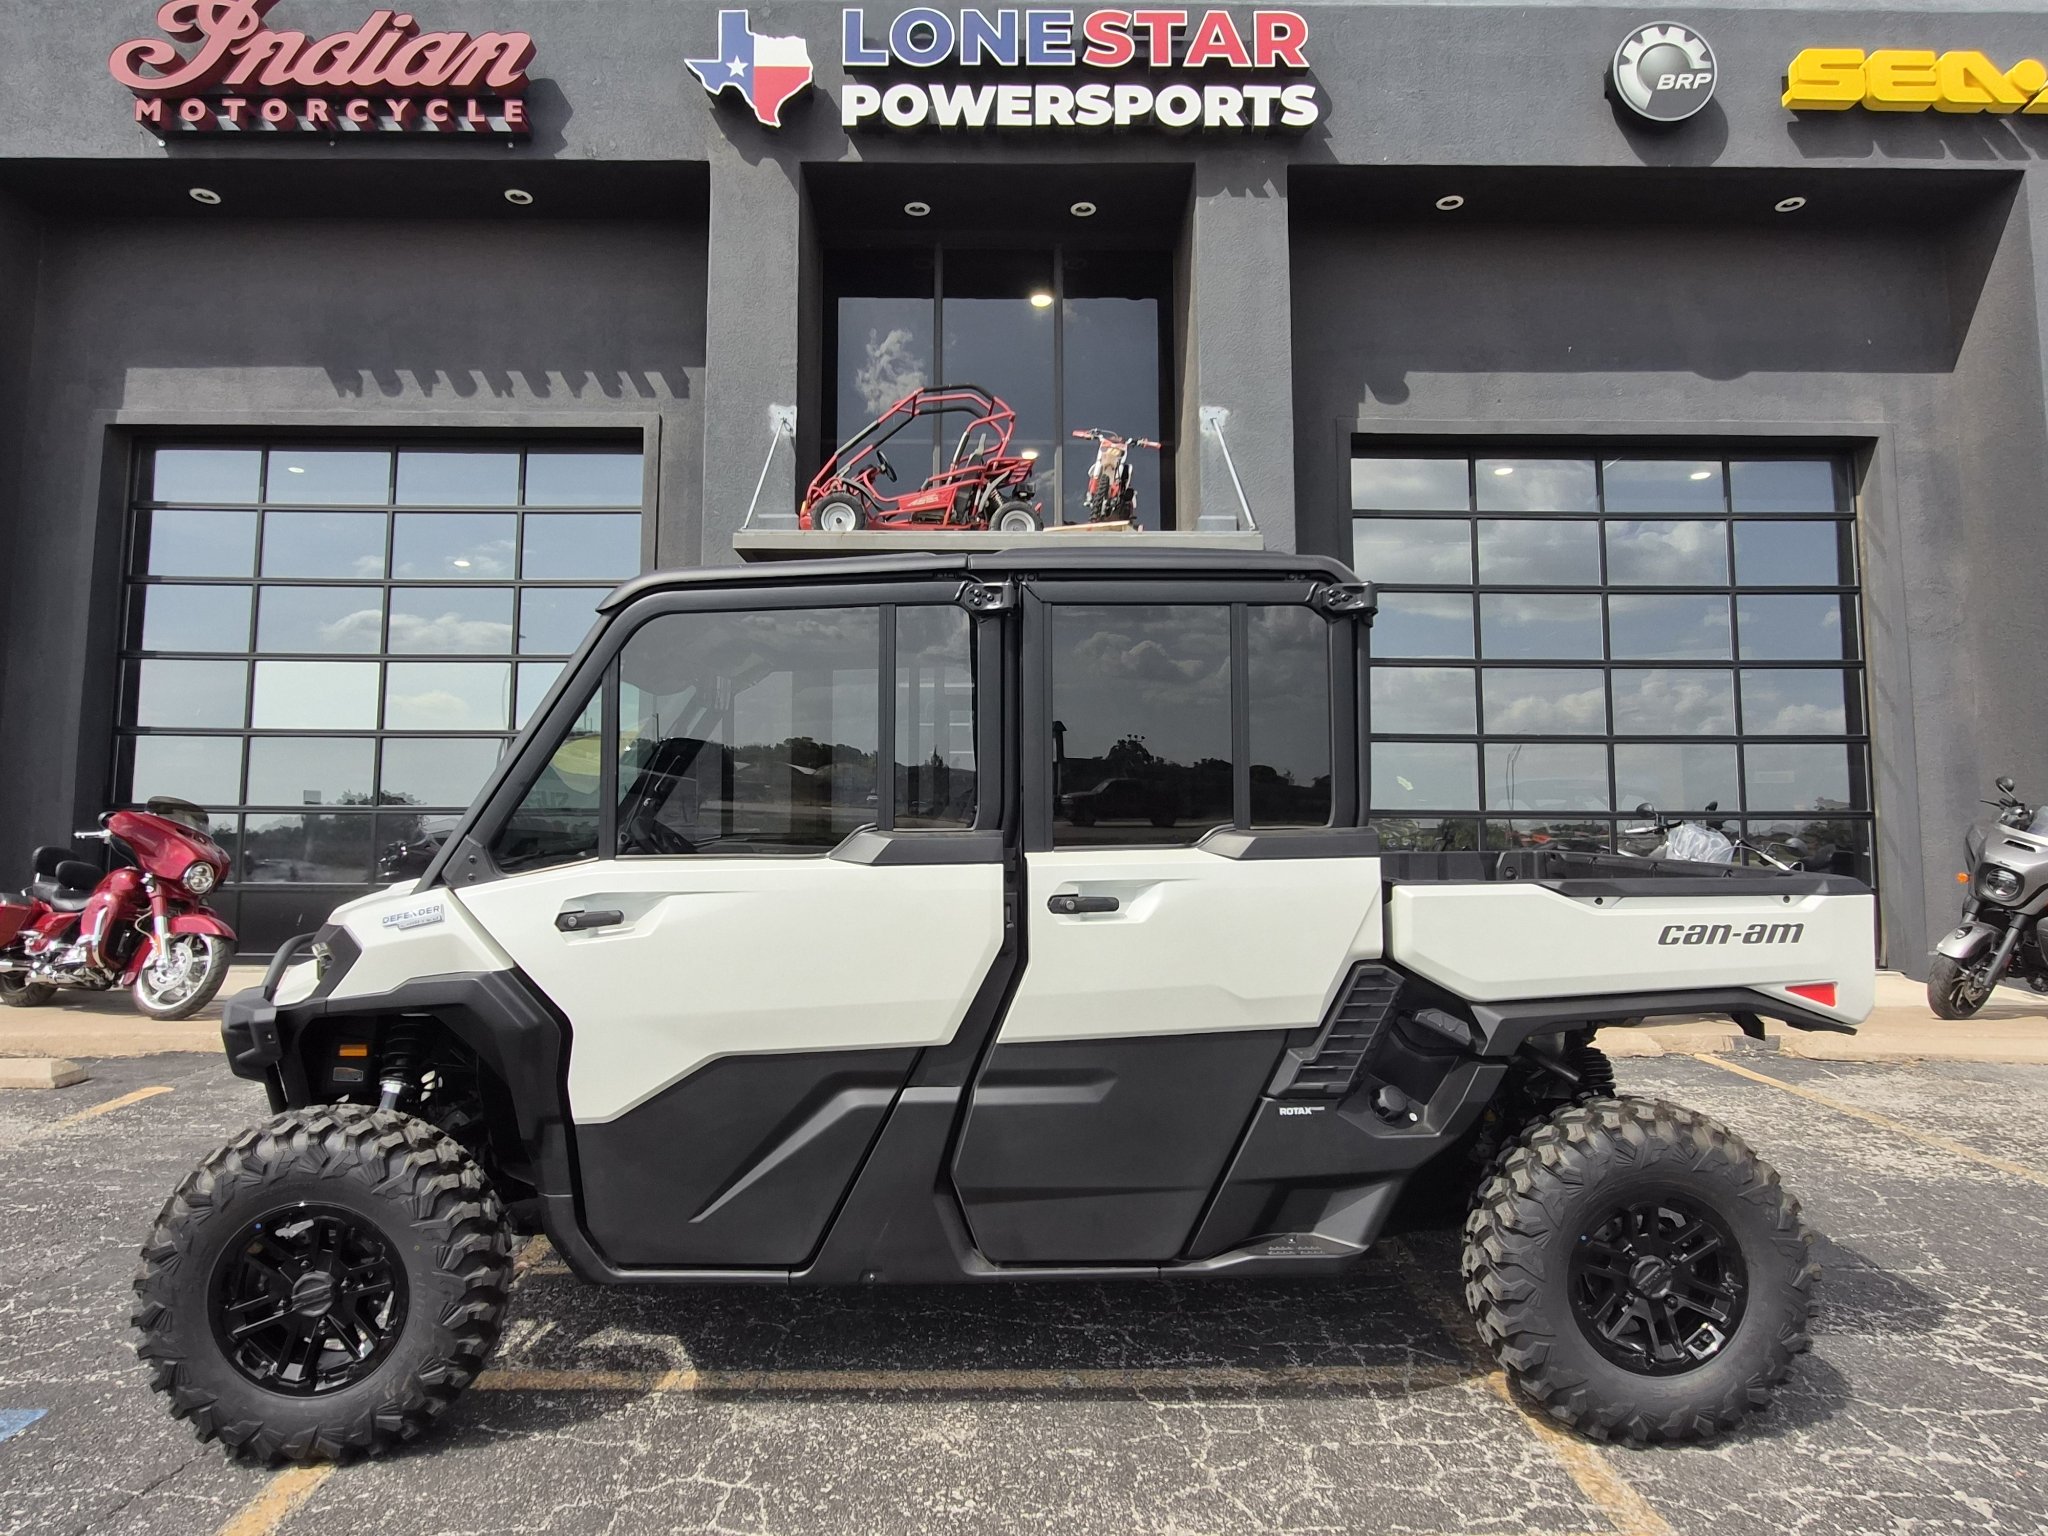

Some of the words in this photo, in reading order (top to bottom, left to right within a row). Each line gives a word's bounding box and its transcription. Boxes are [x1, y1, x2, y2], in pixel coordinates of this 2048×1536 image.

[108, 0, 532, 88] Indian
[1656, 73, 1712, 90] BRP
[135, 98, 524, 122] MOTORCYCLE
[841, 84, 1318, 127] POWERSPORTS
[1658, 923, 1804, 945] can-am
[1279, 1106, 1312, 1116] ROTAX
